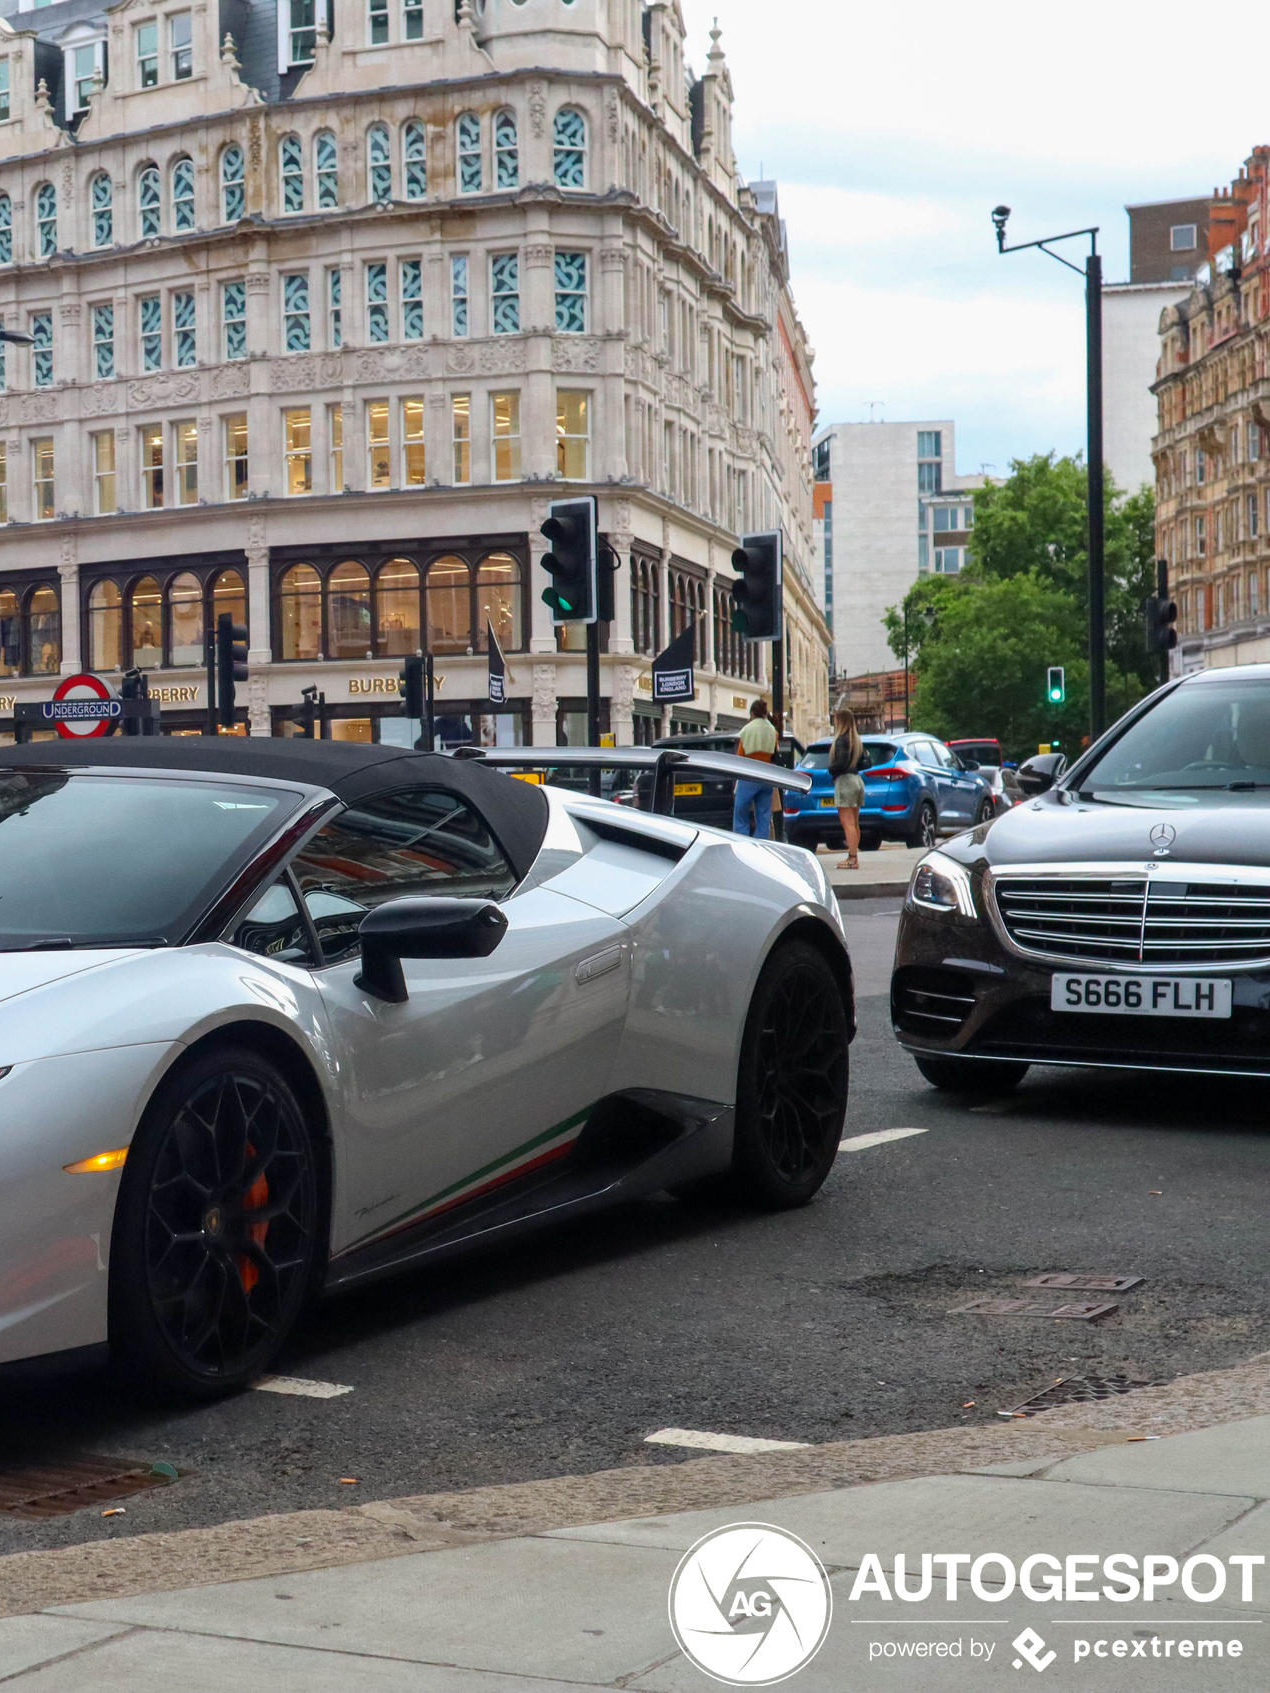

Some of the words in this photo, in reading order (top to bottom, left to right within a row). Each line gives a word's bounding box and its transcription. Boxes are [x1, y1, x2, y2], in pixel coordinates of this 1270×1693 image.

[349, 676, 446, 695] BURBY
[43, 702, 121, 718] UNDERGROUND
[1065, 979, 1142, 1008] S666
[1152, 981, 1215, 1011] FLH
